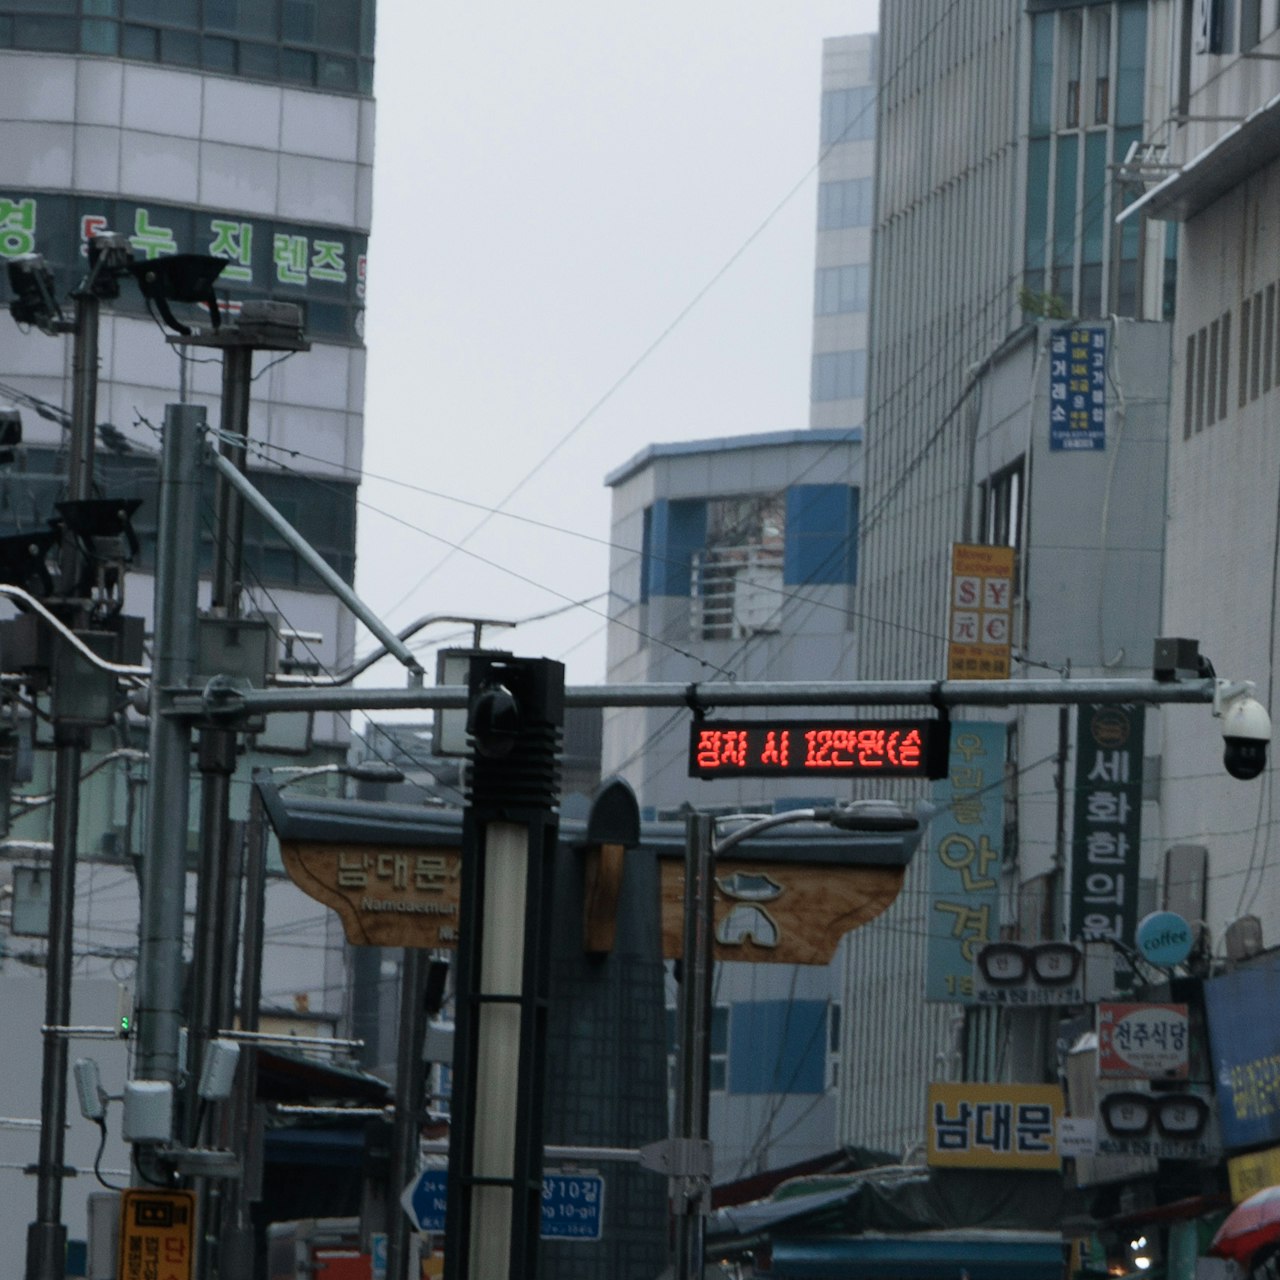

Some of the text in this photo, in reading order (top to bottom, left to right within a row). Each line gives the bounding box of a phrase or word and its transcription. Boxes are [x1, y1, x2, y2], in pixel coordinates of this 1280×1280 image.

[273, 233, 347, 285] 렌즈
[1082, 750, 1132, 941] 세화한의원
[1142, 930, 1188, 952] coffee
[1115, 1021, 1187, 1050] 전주식당
[933, 1101, 1052, 1150] 남대문
